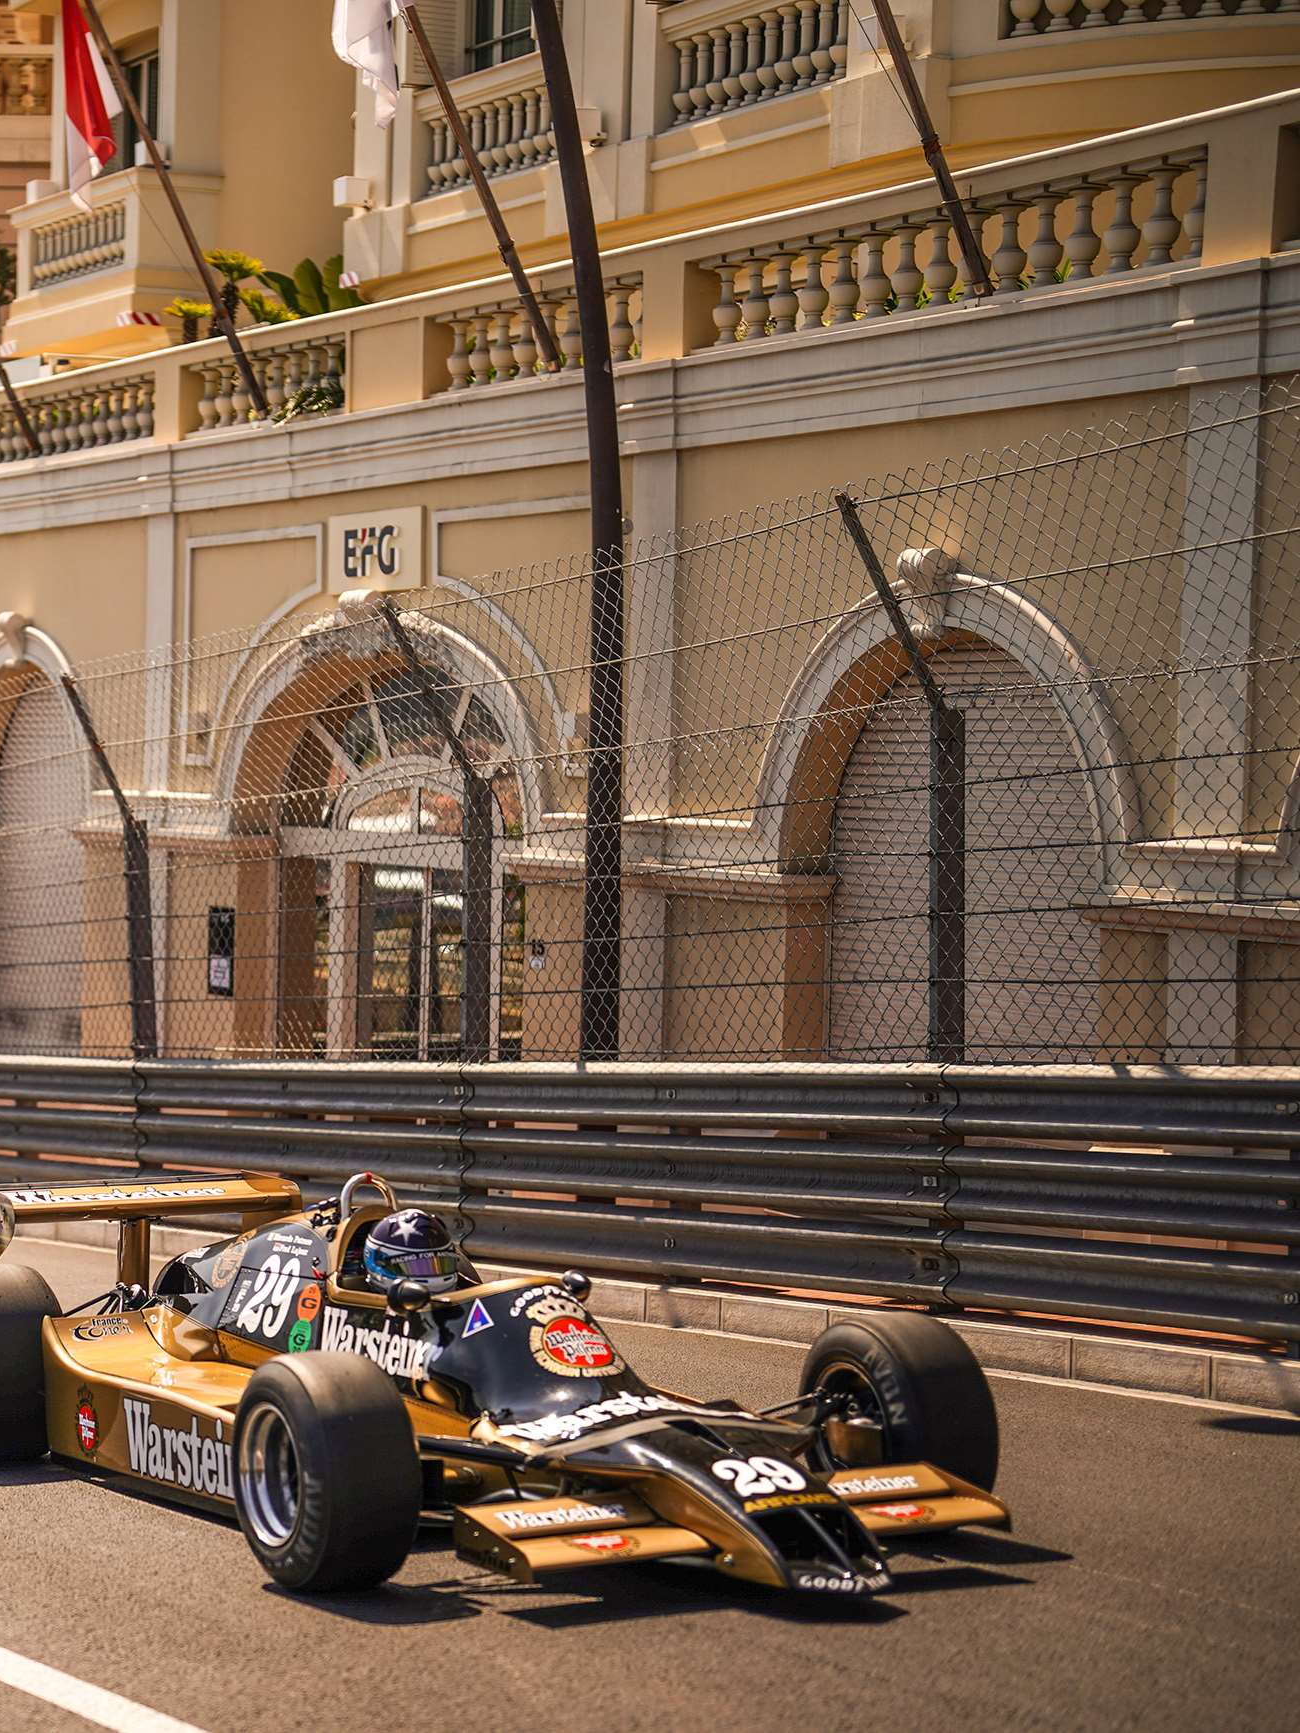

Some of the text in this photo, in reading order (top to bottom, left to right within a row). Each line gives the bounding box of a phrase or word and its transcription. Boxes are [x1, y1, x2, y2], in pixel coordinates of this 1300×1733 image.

[344, 525, 396, 577] EFG
[236, 1254, 300, 1336] 29
[301, 1297, 317, 1310] G
[293, 1333, 306, 1346] G
[864, 1346, 909, 1425] AVON
[711, 1456, 807, 1498] 29
[493, 1504, 626, 1530] Warsteiner
[743, 1493, 839, 1514] ARROWS
